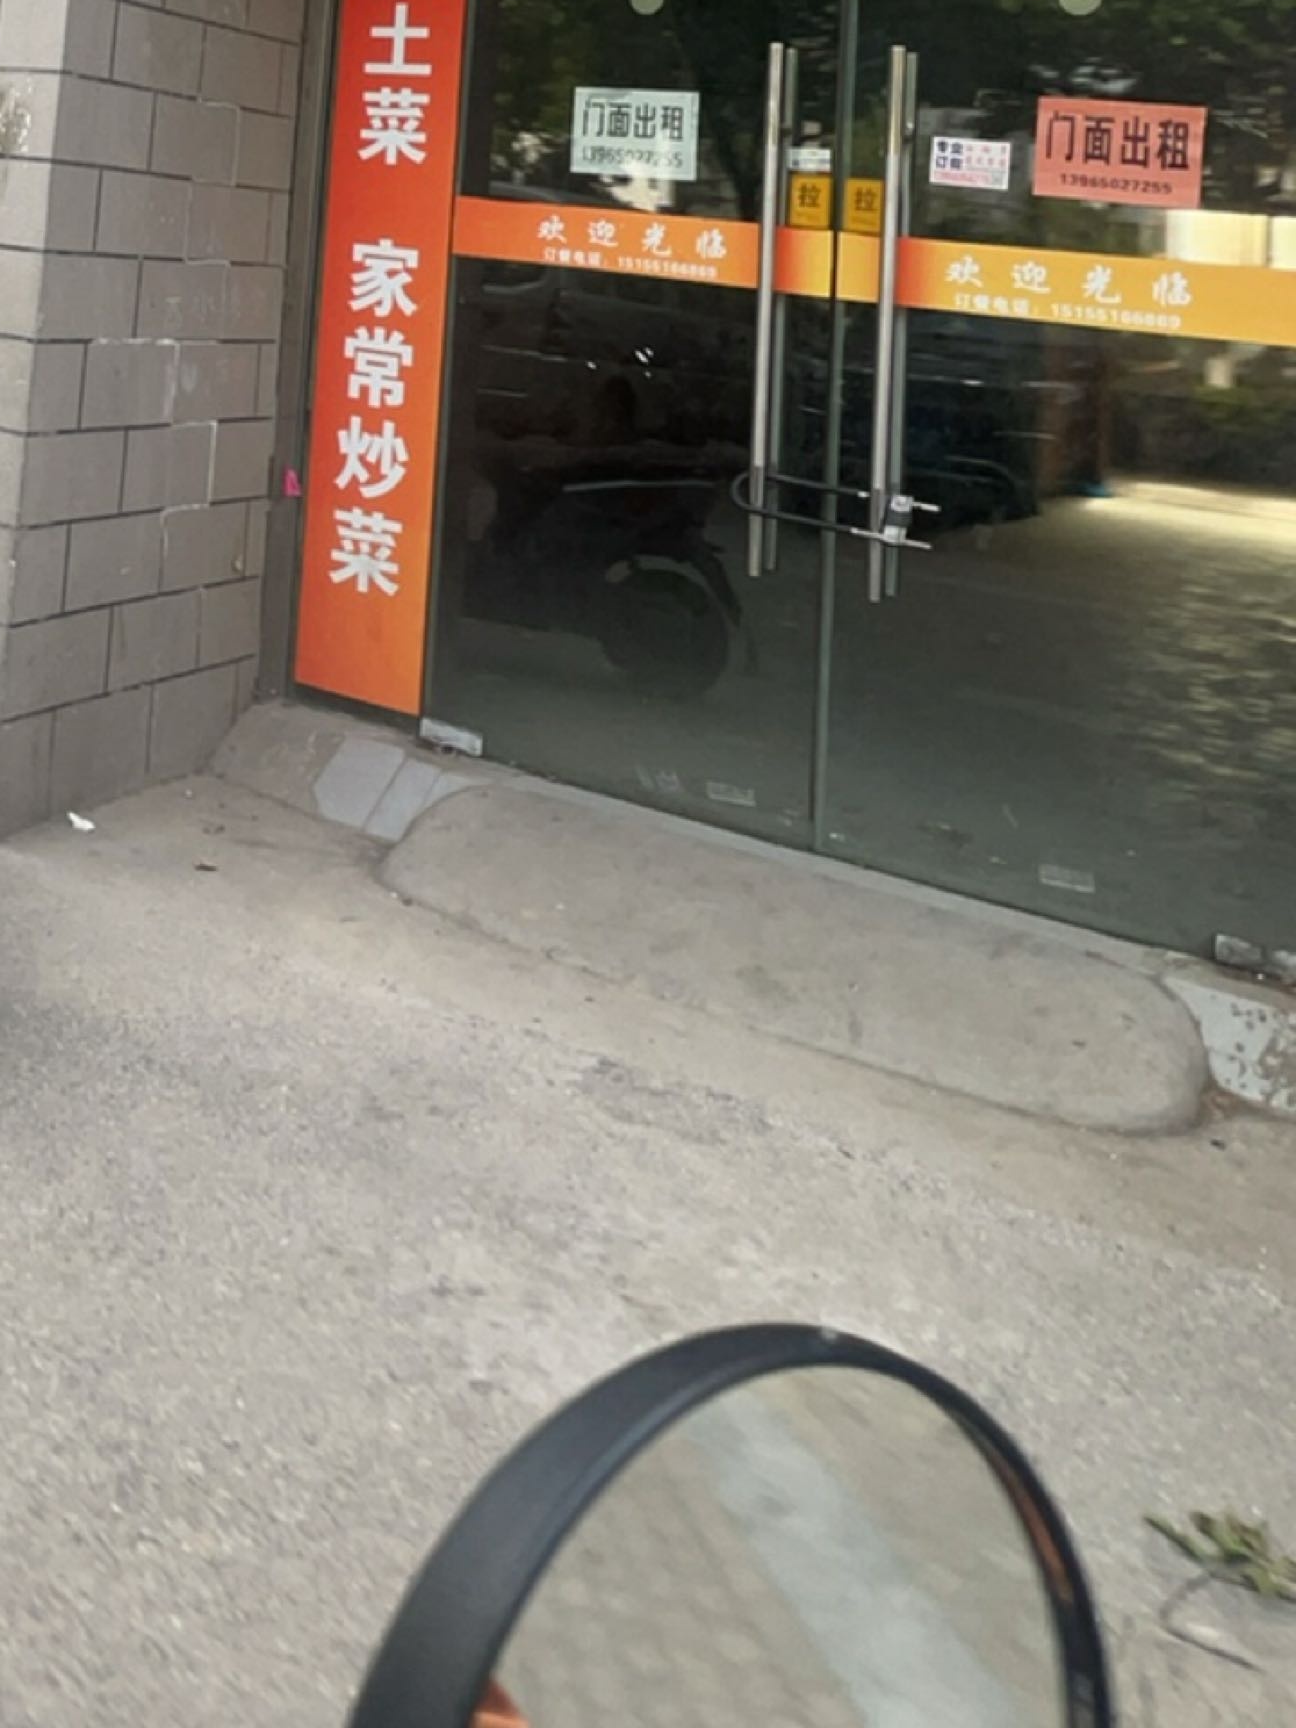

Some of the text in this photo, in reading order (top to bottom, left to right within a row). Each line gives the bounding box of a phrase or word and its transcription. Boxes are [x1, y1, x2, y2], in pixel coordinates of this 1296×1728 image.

[582, 101, 684, 142] 门面出租
[1045, 111, 1190, 171] 门面出租
[537, 214, 727, 259] 欢迎光临
[945, 254, 1191, 307] 欢迎光临
[328, 239, 419, 597] 家常炒菜
